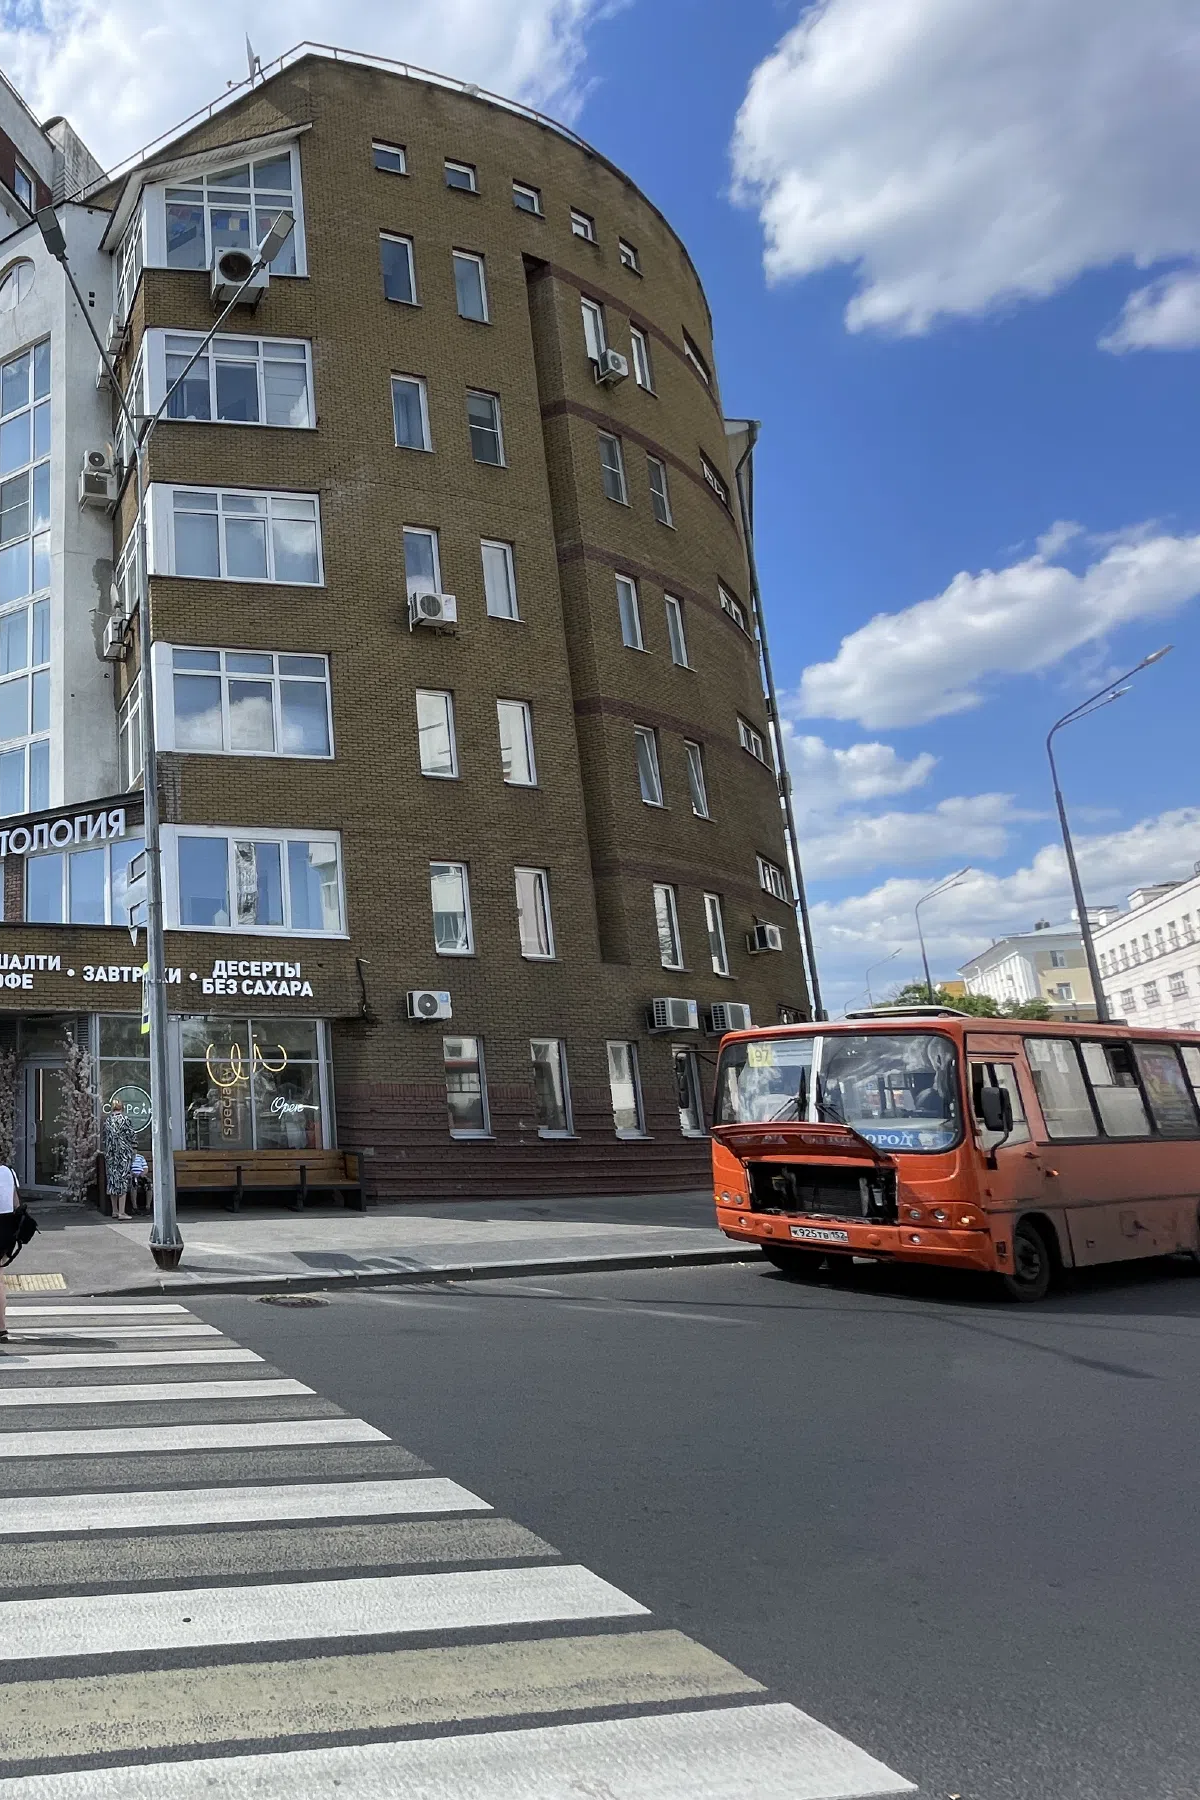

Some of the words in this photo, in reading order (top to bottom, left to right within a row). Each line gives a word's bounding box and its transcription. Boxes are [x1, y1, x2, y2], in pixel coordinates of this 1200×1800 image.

[212, 959, 301, 979] ДЕСЕРТЫ
[202, 978, 238, 995] БЕЗ
[241, 980, 314, 997] САХАРА
